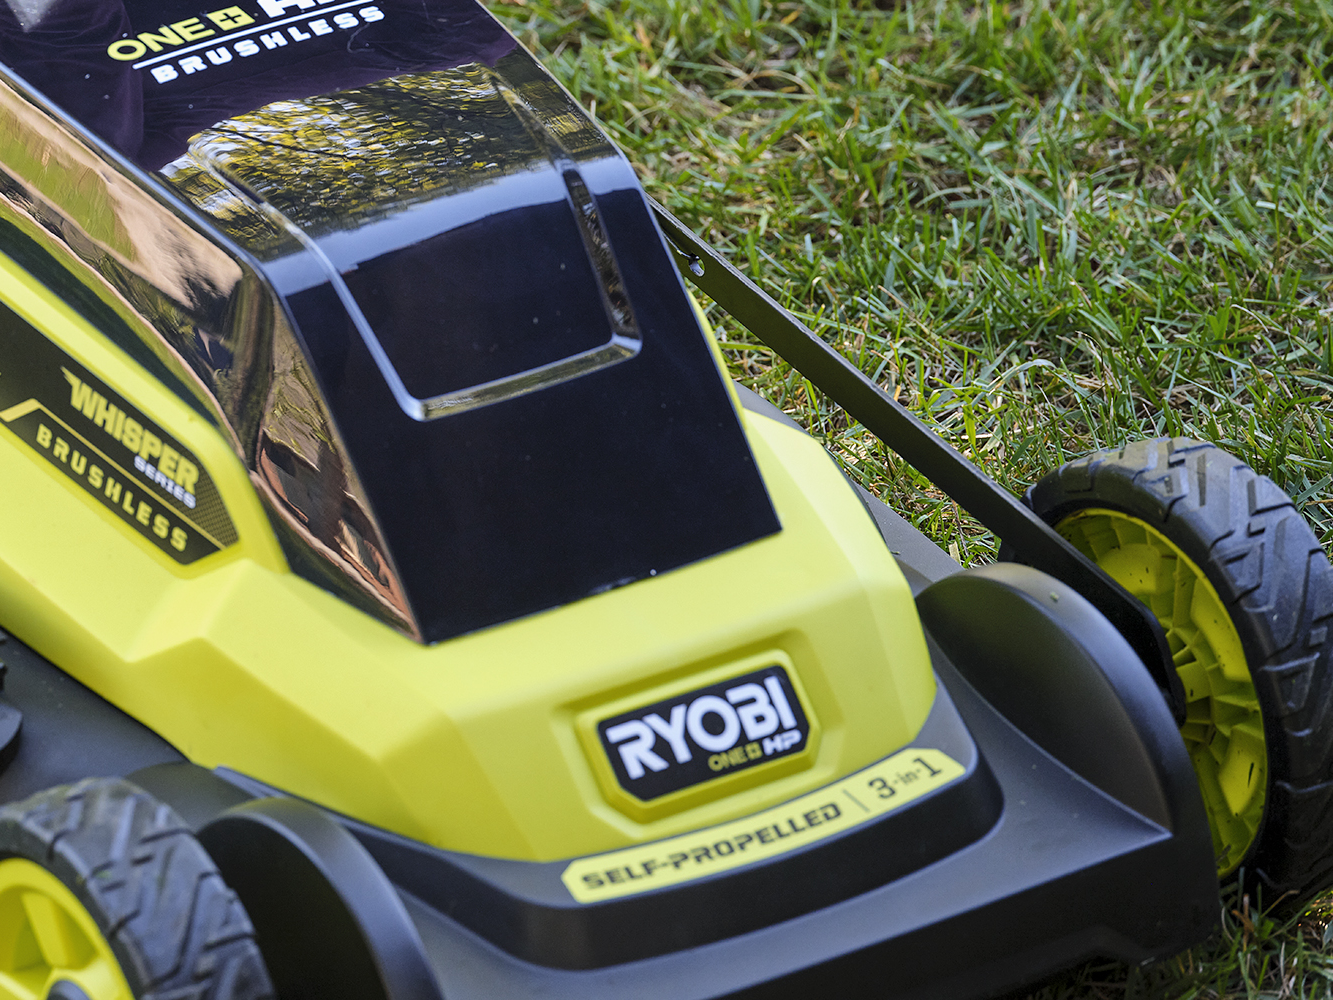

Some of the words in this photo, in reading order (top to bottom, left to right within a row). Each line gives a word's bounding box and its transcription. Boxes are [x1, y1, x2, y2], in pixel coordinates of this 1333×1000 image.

[150, 5, 385, 85] BRUSHLESS
[60, 367, 200, 495] WHISPER
[36, 423, 189, 552] BRUSHLESS
[134, 455, 196, 509] SERIES
[606, 675, 799, 780] RYOBI
[762, 729, 802, 756] HP
[582, 802, 843, 890] SELF-PROPELLED
